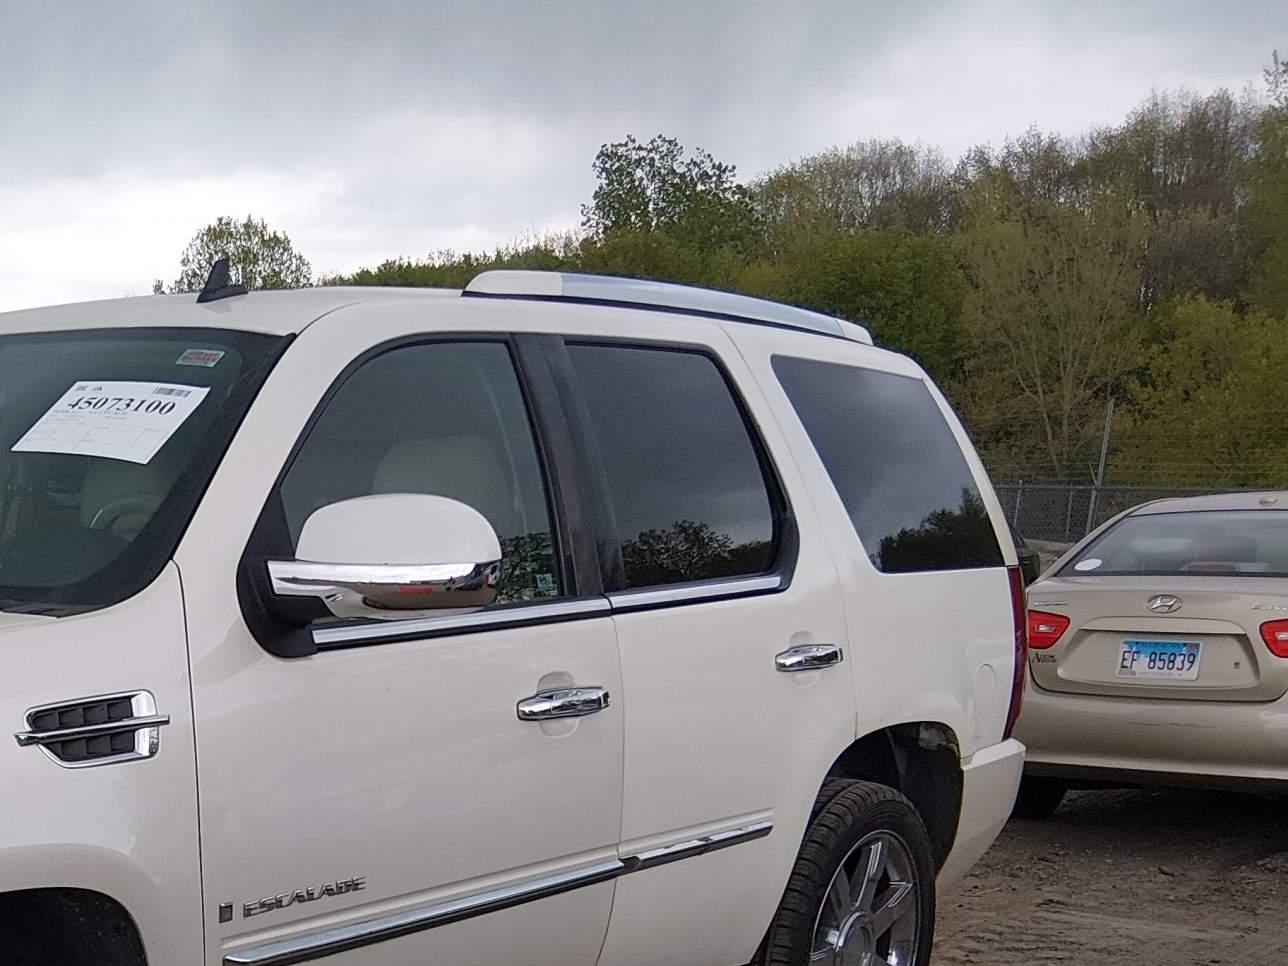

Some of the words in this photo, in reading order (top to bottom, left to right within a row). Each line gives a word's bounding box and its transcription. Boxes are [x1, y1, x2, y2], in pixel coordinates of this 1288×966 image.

[68, 396, 176, 416] 45073100
[1120, 650, 1141, 670] EF
[1147, 651, 1196, 672] 85839
[243, 876, 366, 918] ESCALADE
